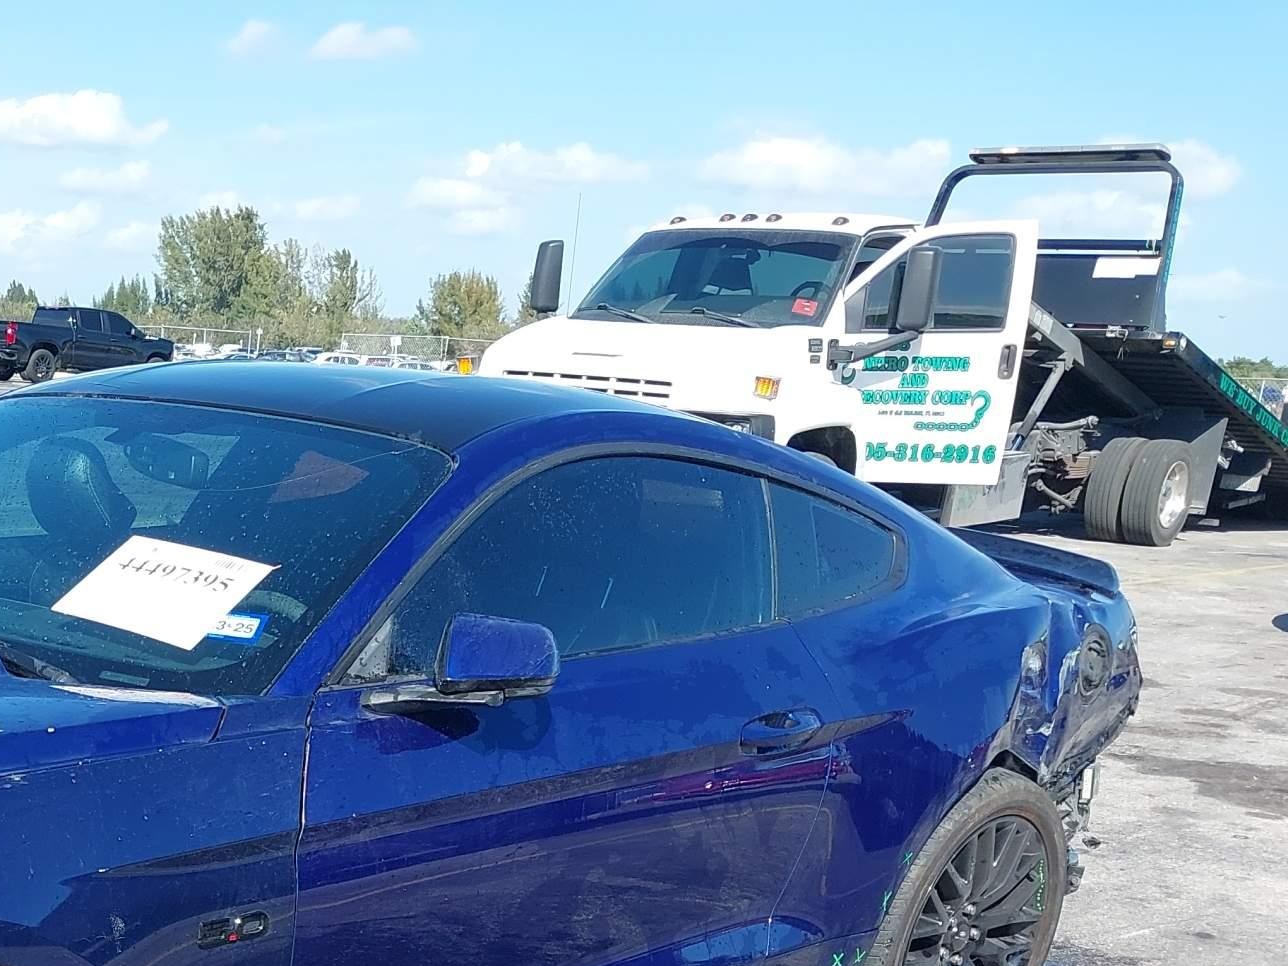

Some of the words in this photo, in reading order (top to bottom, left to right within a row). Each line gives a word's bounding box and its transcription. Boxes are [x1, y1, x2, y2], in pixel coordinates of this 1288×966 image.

[912, 356, 970, 372] TOWING
[898, 373, 929, 389] AND
[861, 390, 928, 405] ECOVERY
[931, 390, 973, 405] CORP
[1220, 373, 1236, 398] WE
[1236, 390, 1257, 415] BUY
[1255, 408, 1281, 438] JUNK
[118, 557, 234, 591] 44497395
